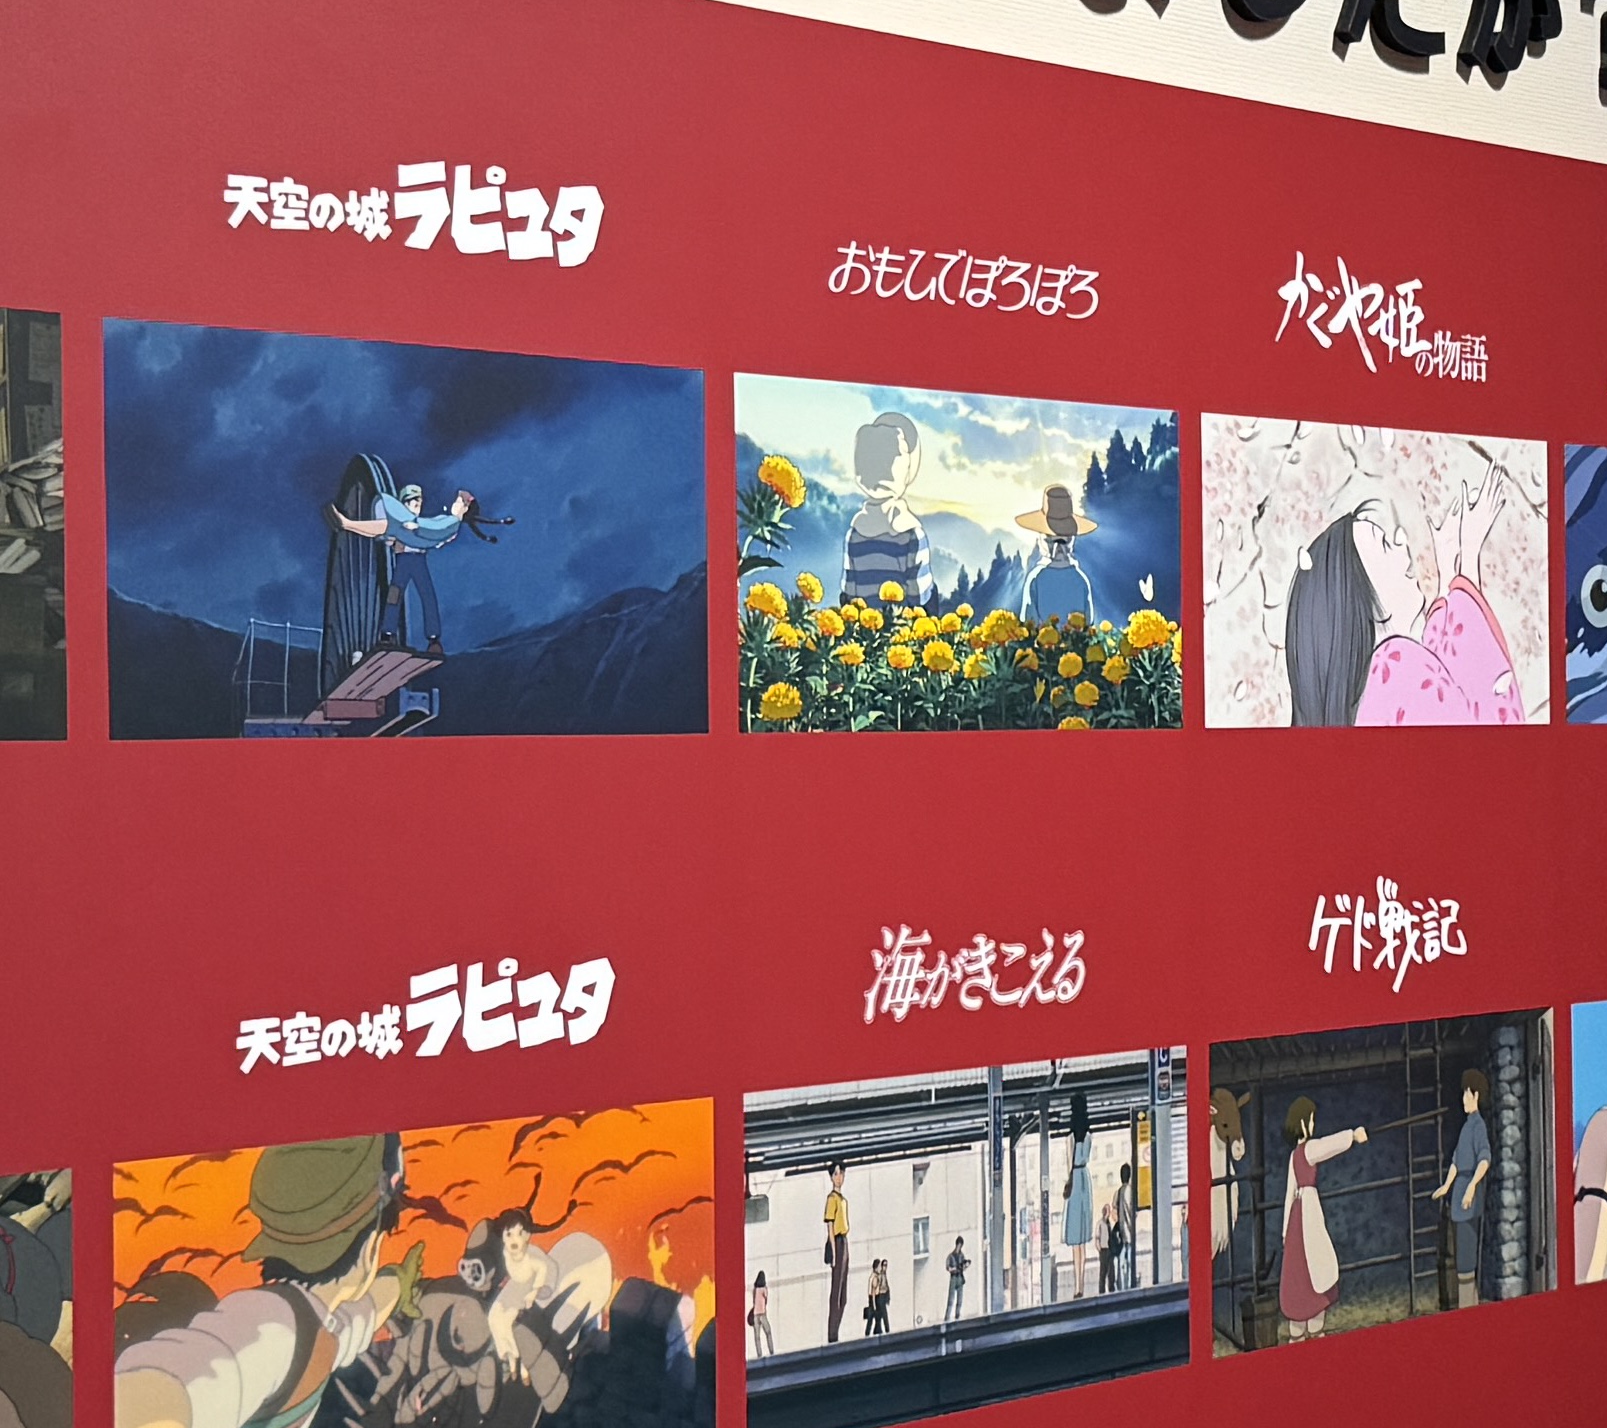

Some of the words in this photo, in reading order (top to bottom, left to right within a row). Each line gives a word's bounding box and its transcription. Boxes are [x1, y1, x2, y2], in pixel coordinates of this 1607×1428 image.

[223, 161, 605, 268] 天空の城ラピュタ
[827, 240, 1100, 320] おもひでぽろぽろ
[1275, 251, 1489, 383] かぐや姫の物語
[863, 924, 1087, 1025] 海がきこえる
[1309, 876, 1468, 993] ゲド戦記
[236, 958, 616, 1075] 天空の城ラピュタ
